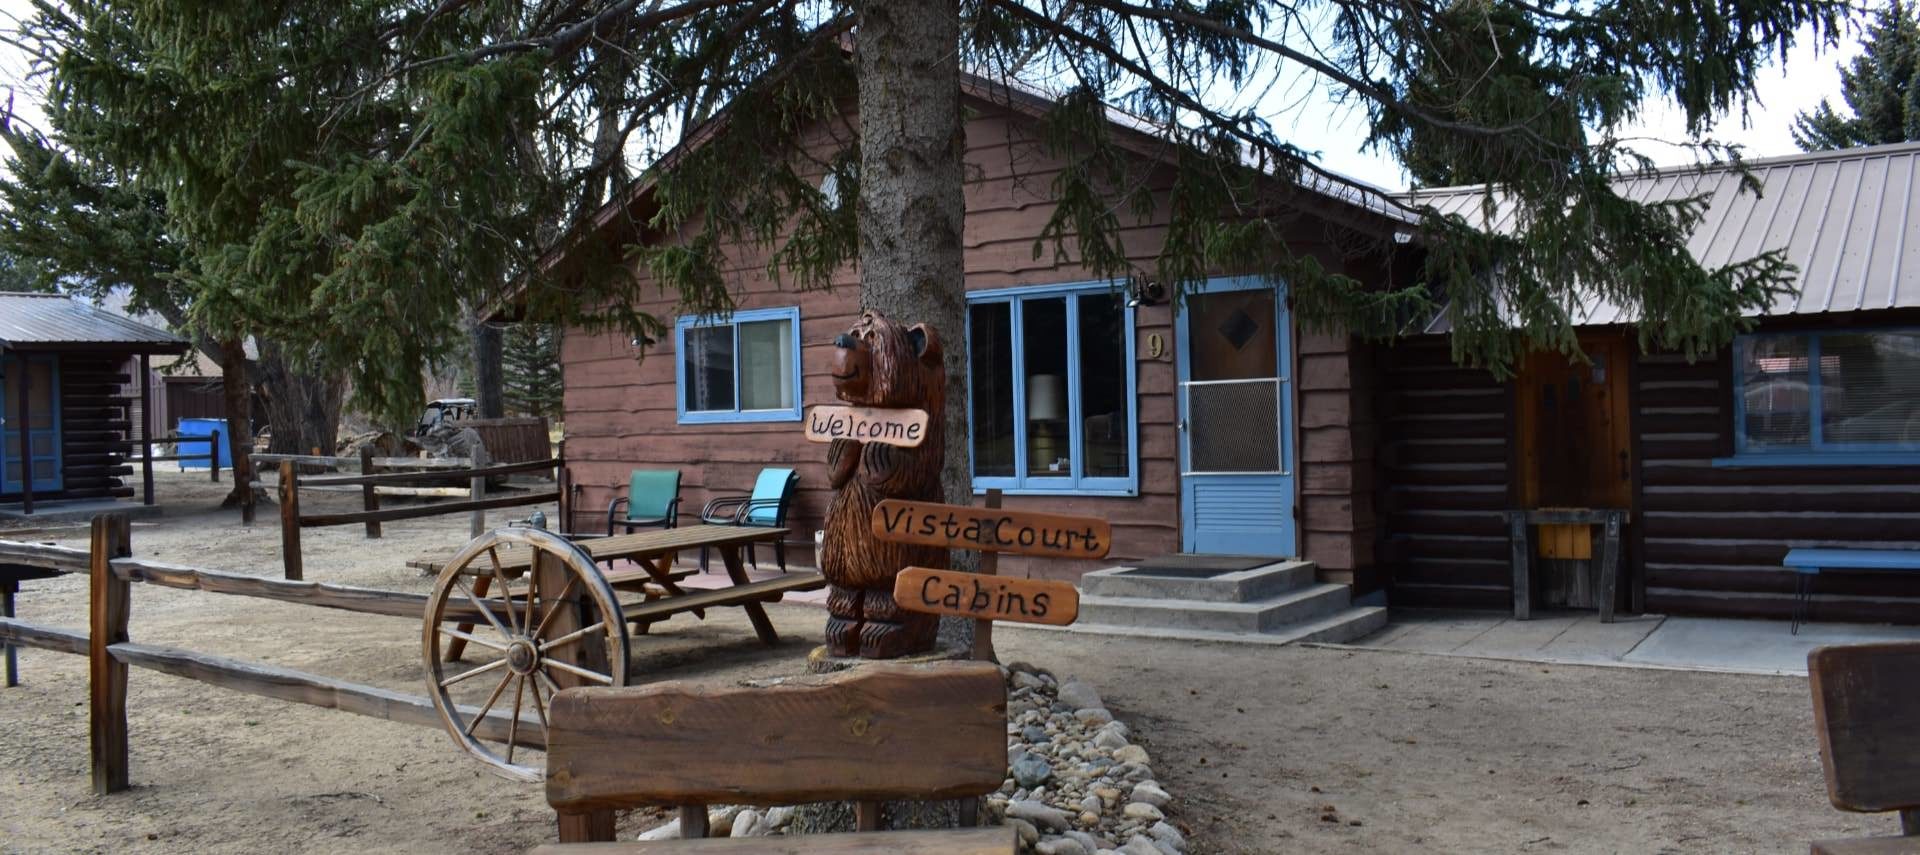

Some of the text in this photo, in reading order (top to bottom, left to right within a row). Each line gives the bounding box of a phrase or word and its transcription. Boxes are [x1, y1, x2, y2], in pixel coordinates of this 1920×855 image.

[1147, 333, 1163, 359] 9
[811, 412, 921, 441] Welcome
[880, 506, 1101, 552] Vista Court
[921, 575, 1051, 618] Cabins
